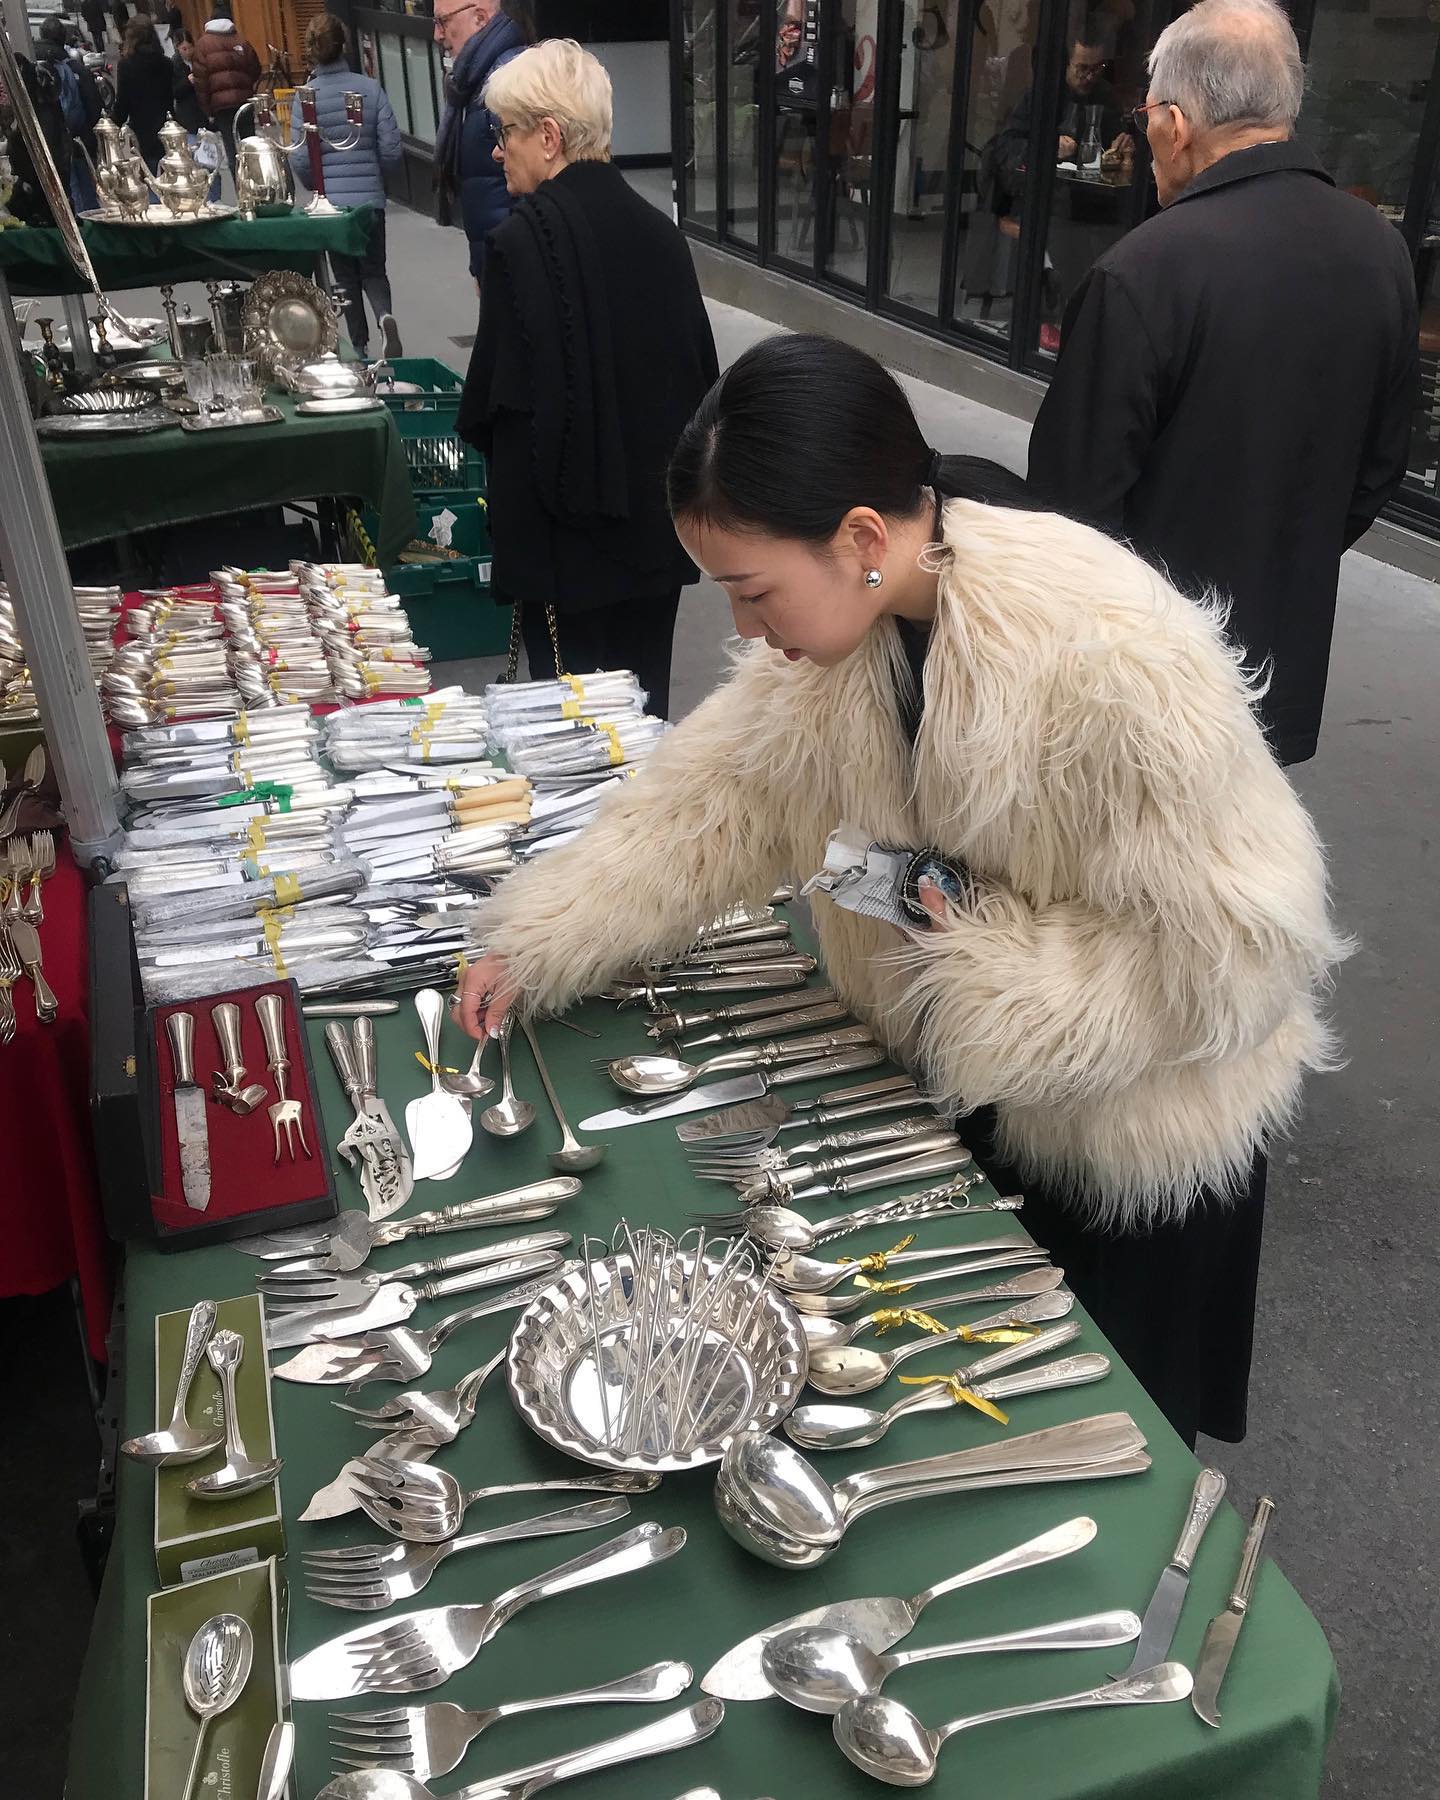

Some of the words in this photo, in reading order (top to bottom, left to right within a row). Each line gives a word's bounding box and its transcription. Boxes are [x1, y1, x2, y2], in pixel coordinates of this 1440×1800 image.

[211, 1390, 224, 1427] Christofle
[200, 1553, 238, 1568] Christofle
[216, 1747, 231, 1800] Christofle
